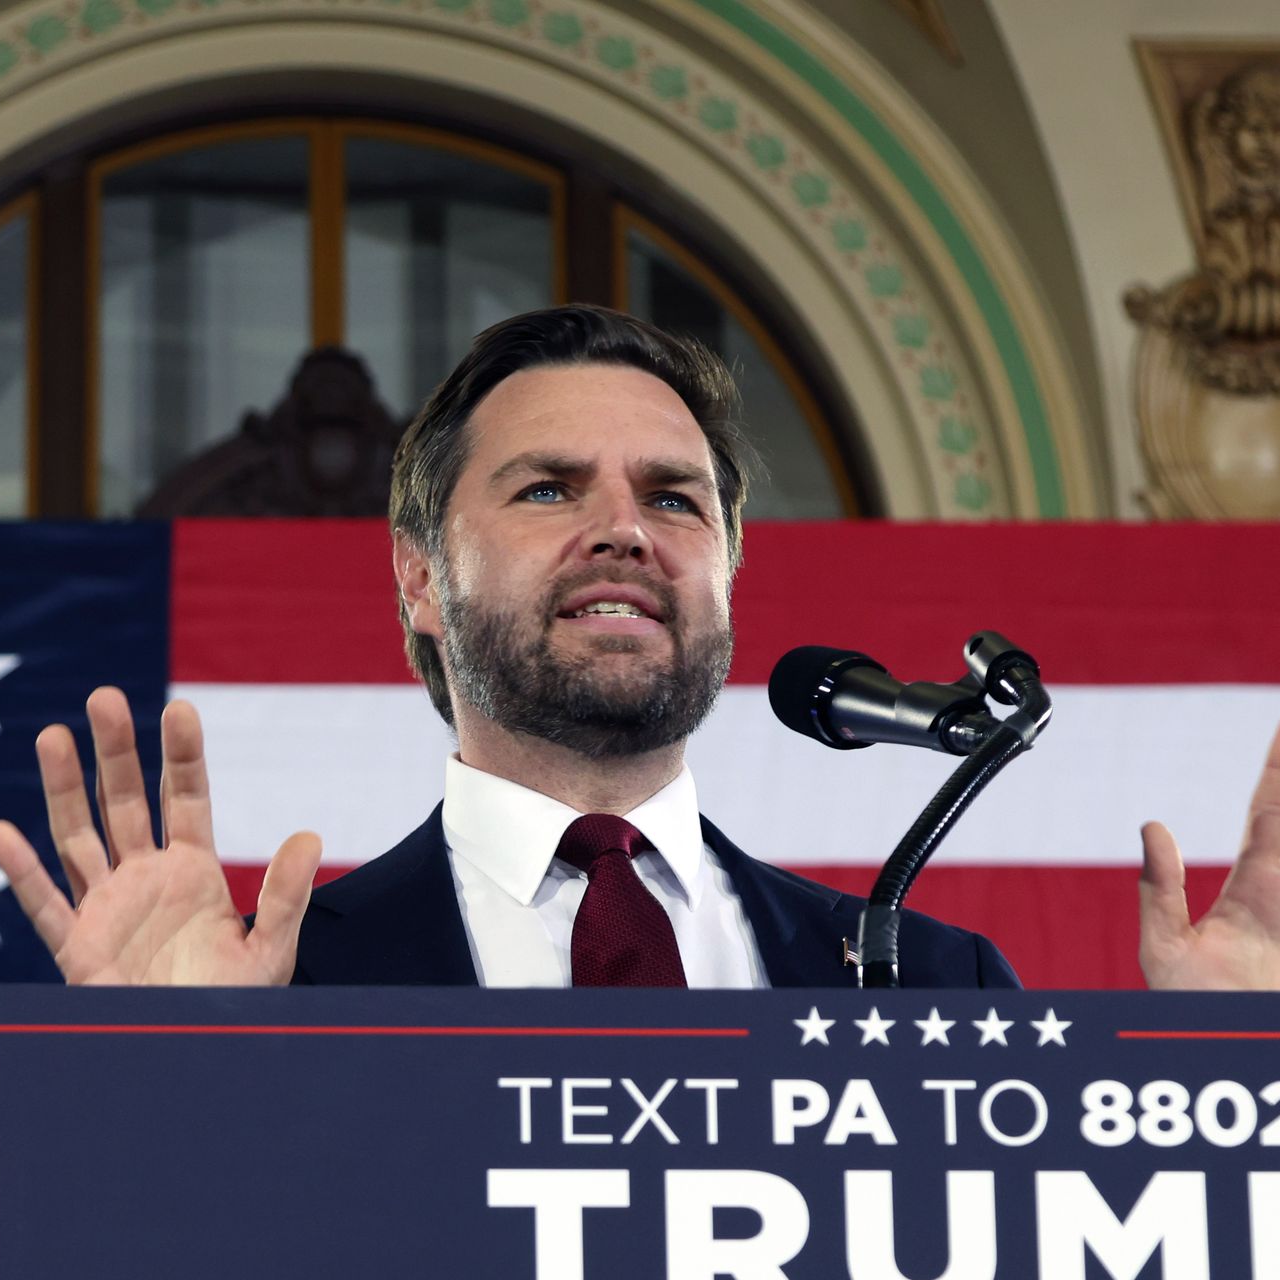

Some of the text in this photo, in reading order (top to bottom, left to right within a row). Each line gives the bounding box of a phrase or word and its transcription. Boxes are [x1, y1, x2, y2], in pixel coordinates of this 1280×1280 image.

[497, 1077, 739, 1145] TEXT
[771, 1078, 898, 1146] PA
[922, 1079, 1049, 1147] TO
